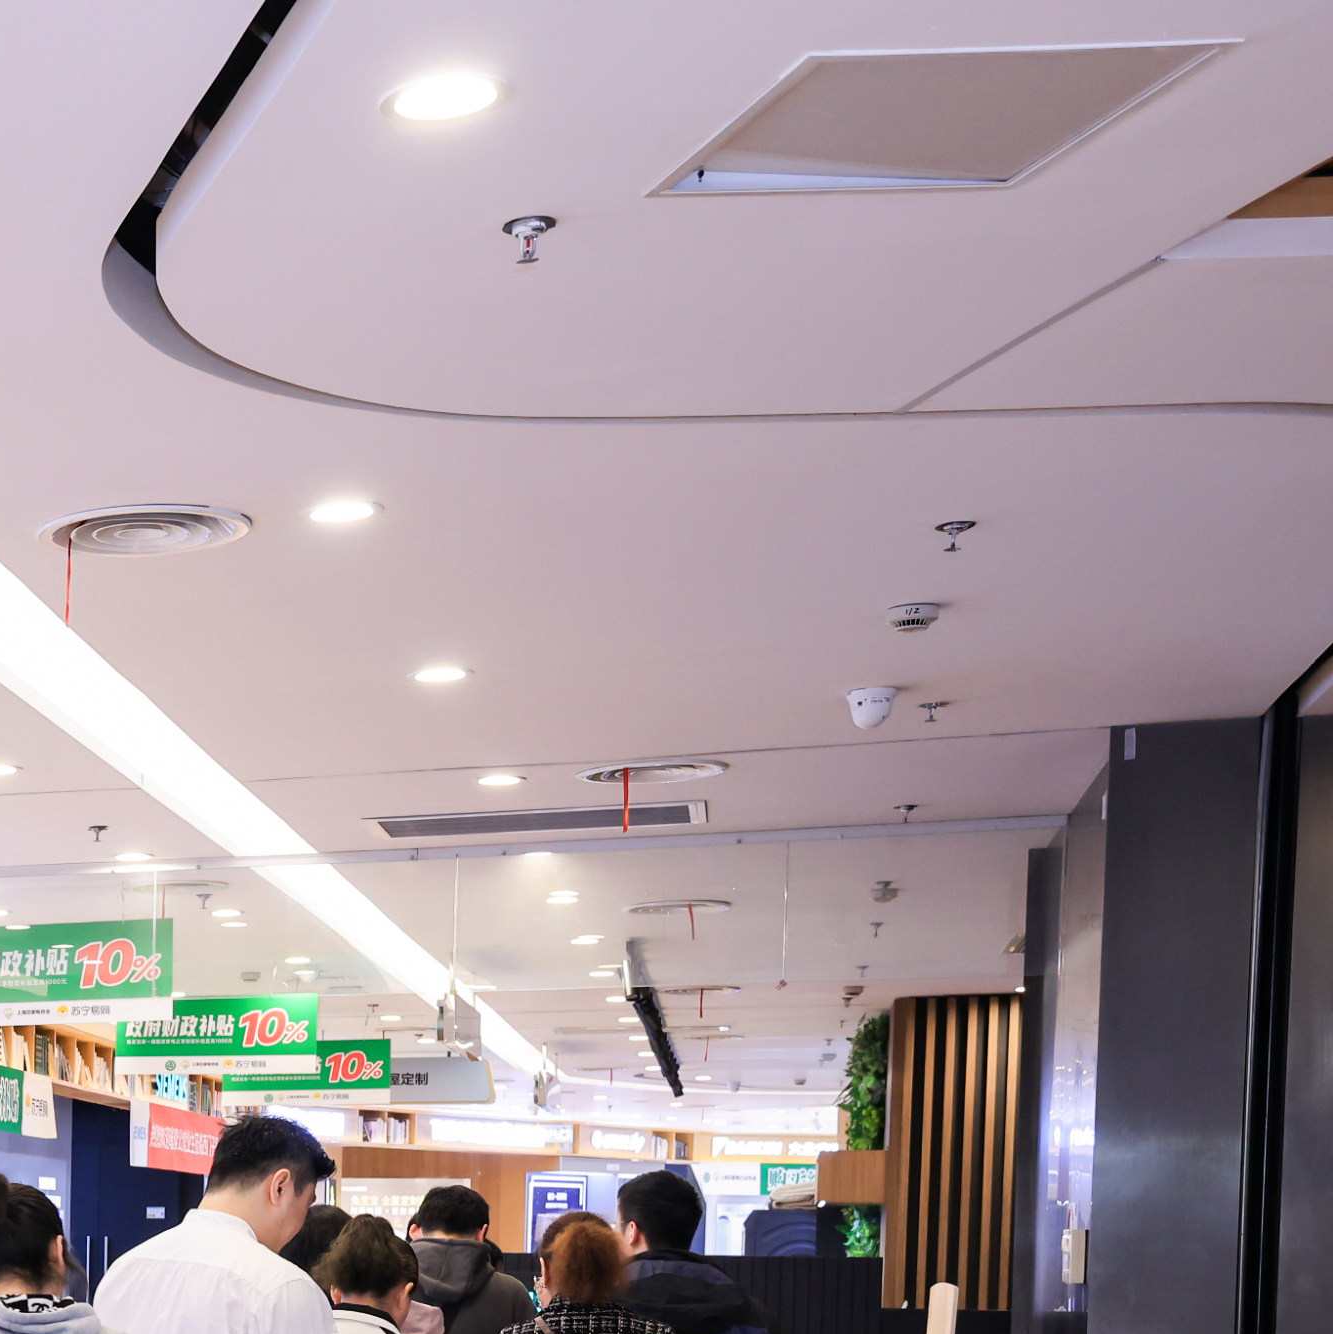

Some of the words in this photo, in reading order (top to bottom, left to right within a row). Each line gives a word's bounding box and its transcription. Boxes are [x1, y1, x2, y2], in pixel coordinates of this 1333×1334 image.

[74, 938, 161, 989] 10%
[126, 1014, 235, 1038] 政府财政补贴
[239, 1008, 310, 1048] 10%
[324, 1050, 384, 1083] 10%
